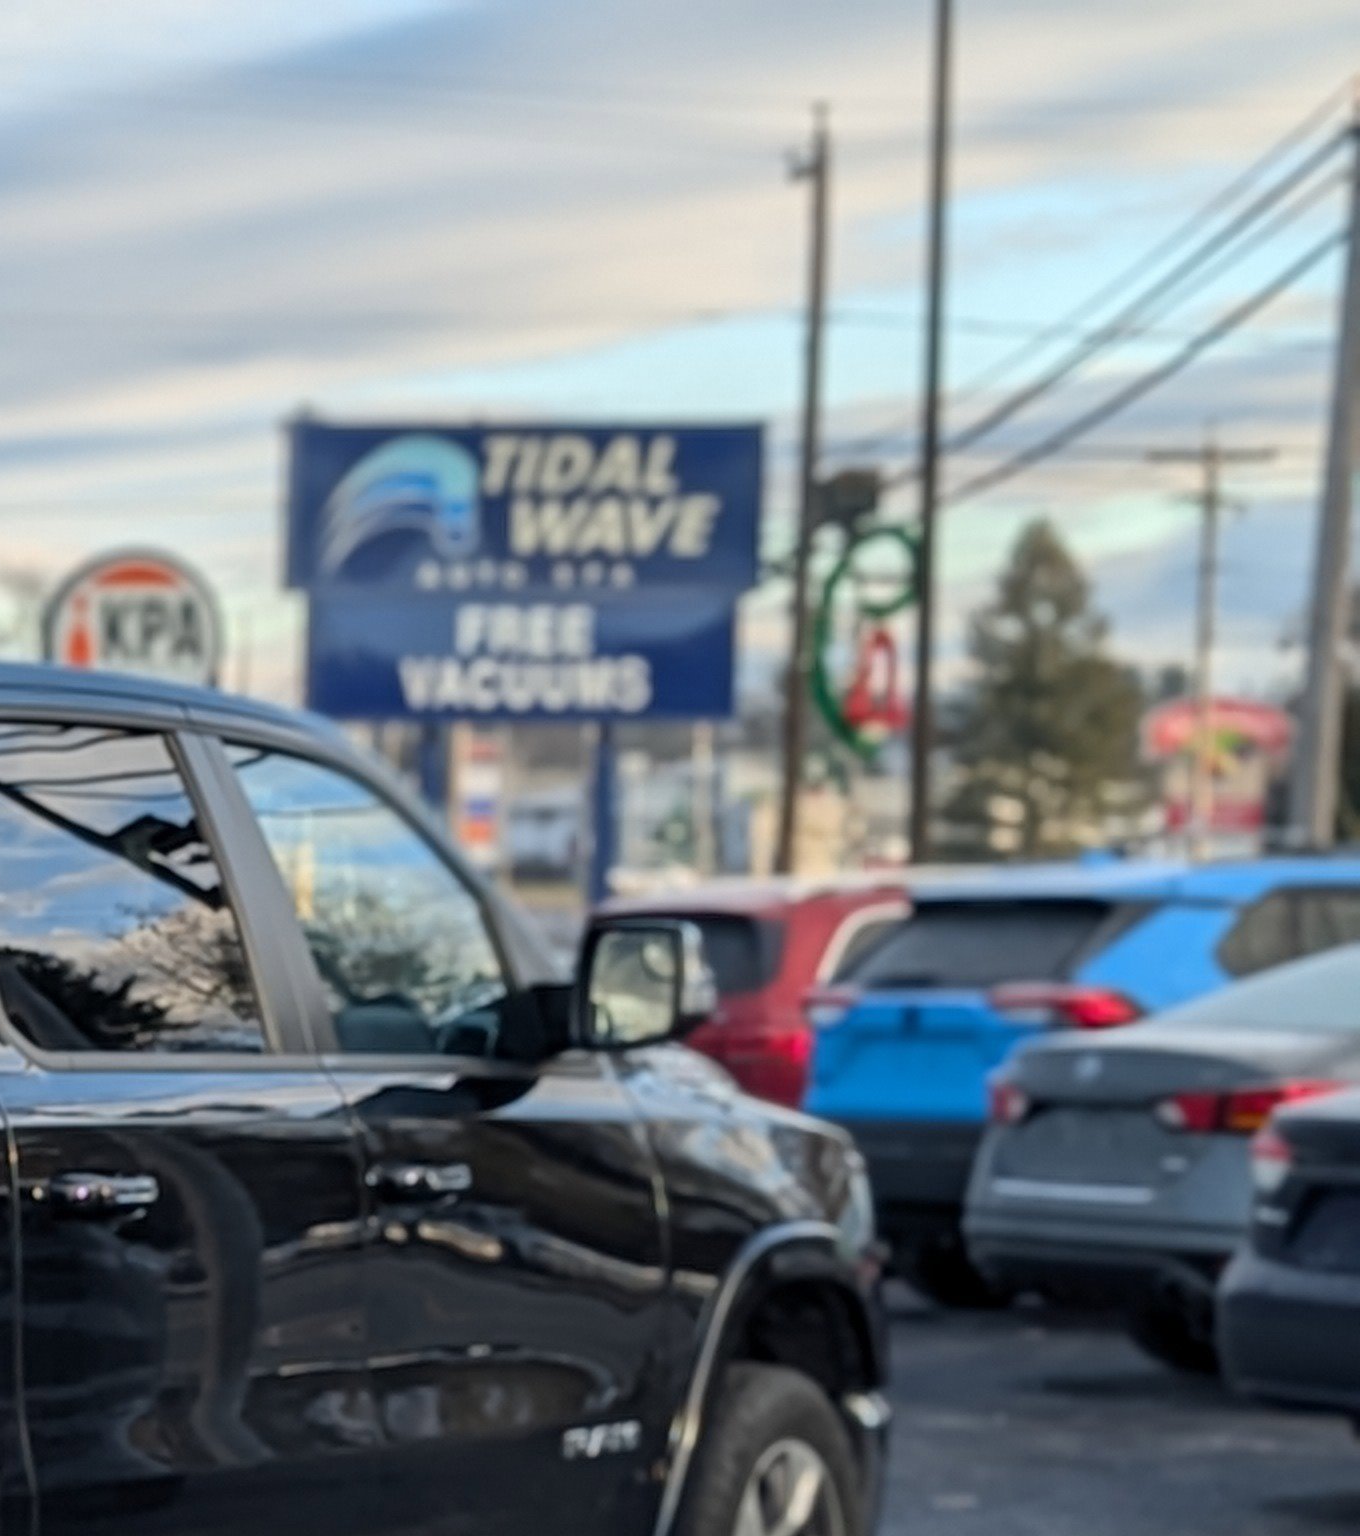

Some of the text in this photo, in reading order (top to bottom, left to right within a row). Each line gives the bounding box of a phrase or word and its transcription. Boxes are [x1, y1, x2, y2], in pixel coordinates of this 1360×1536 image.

[482, 433, 678, 496] TIDAL
[506, 493, 721, 558] WAVE
[454, 603, 595, 657] FREE
[397, 655, 653, 714] VACUUMS
